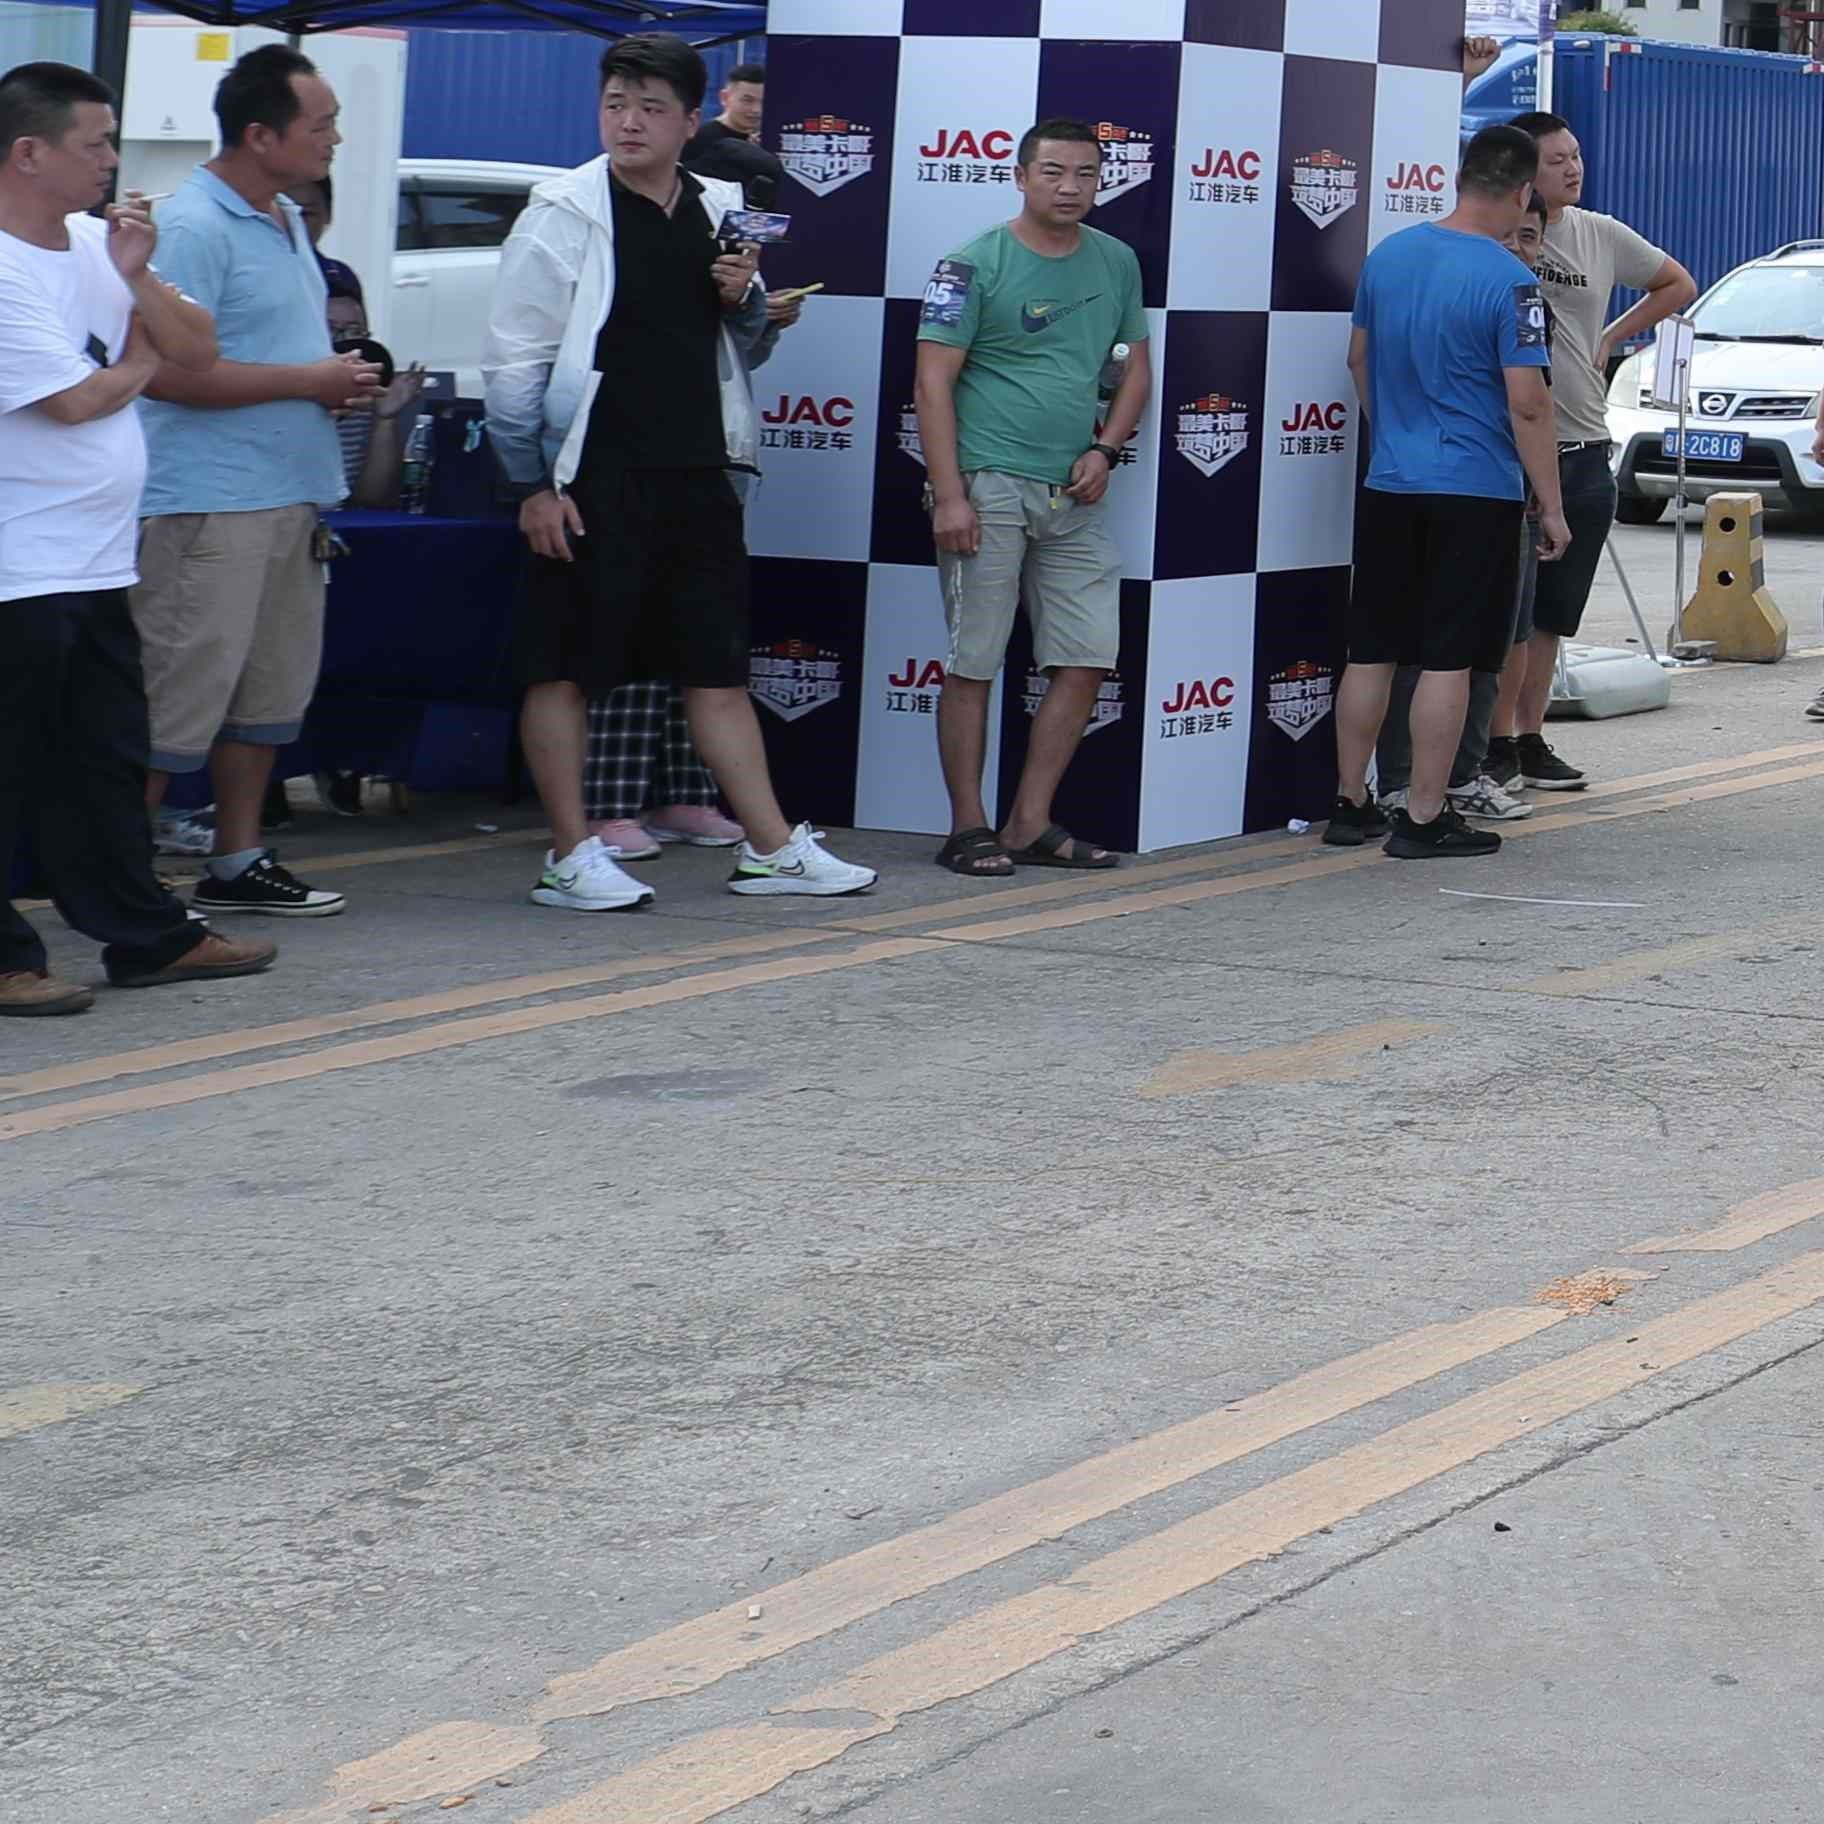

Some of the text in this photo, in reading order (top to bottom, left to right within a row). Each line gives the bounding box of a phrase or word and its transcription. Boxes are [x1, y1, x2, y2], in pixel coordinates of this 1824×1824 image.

[920, 129, 1012, 161] JAC
[917, 162, 1016, 184] 江淮汽车
[1192, 149, 1260, 181] JAC
[1385, 164, 1443, 192] JAC
[1189, 182, 1259, 204] 江淮汽车
[1384, 192, 1444, 215] 江淮汽车
[762, 396, 853, 427] JAC
[1281, 402, 1345, 433] JAC
[759, 428, 853, 451] 江淮汽车
[1279, 433, 1345, 457] 江淮汽车
[889, 658, 945, 687] JA
[1161, 677, 1234, 714] JAC
[1160, 713, 1233, 739] 江淮汽车
